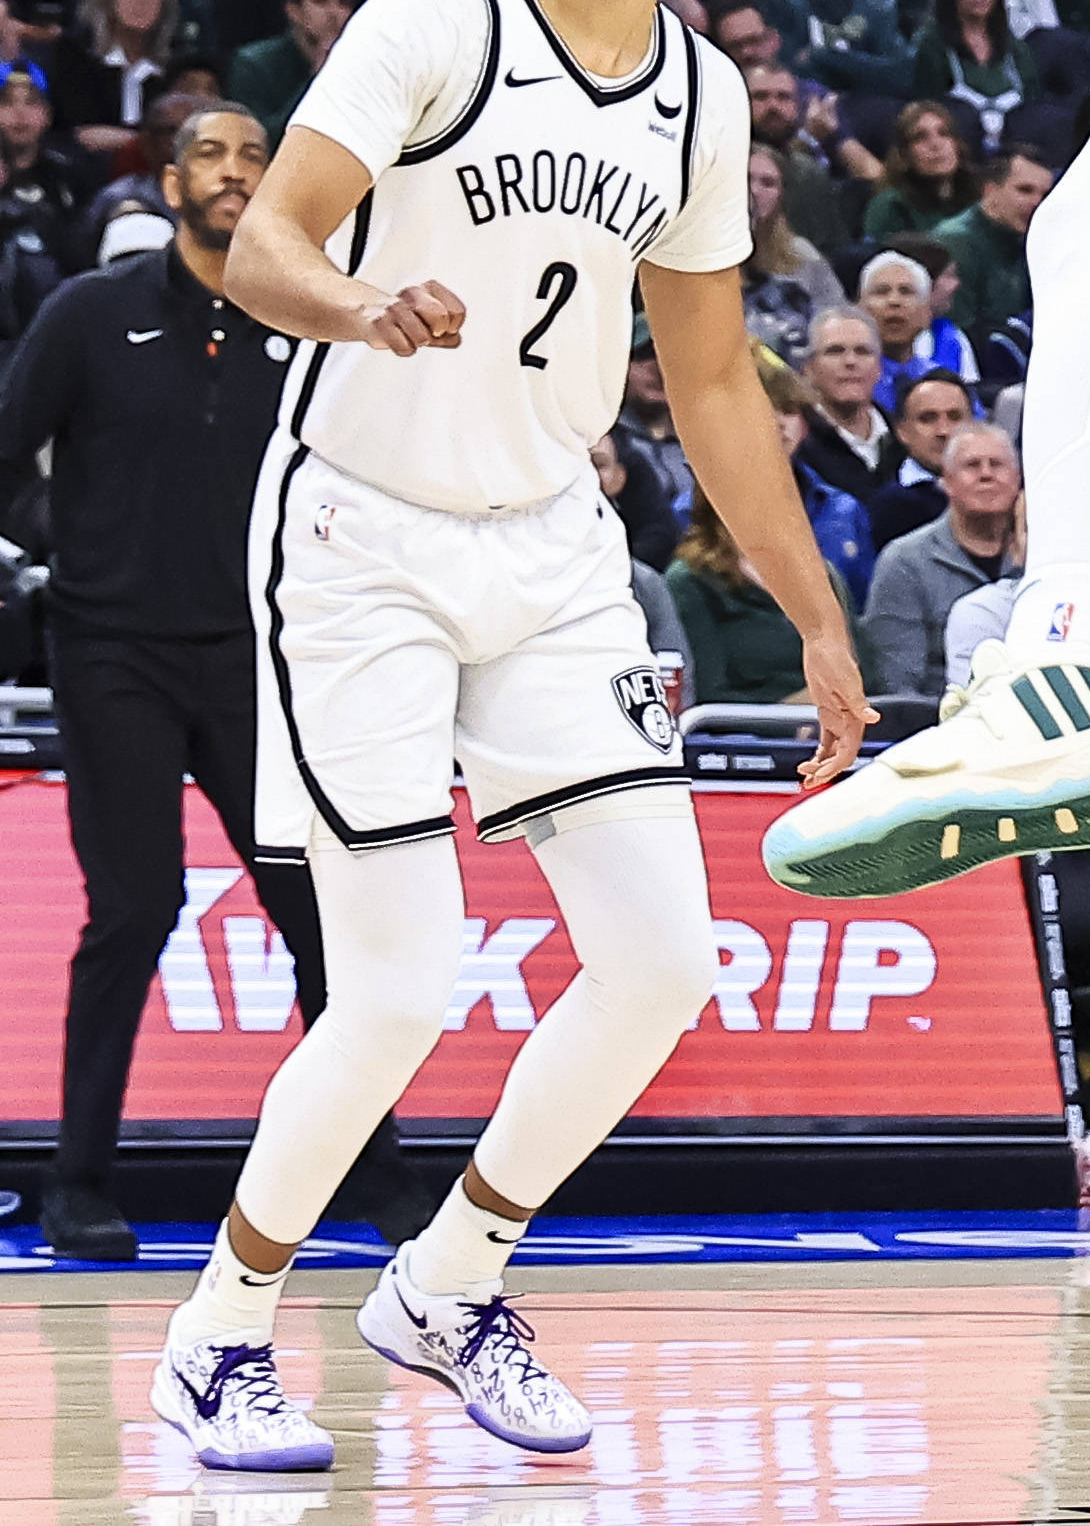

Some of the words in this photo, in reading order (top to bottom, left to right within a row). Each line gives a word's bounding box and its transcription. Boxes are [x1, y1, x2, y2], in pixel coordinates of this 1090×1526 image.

[456, 150, 669, 262] BROOKLYN
[519, 261, 578, 371] 2
[686, 919, 938, 1031] RIP
